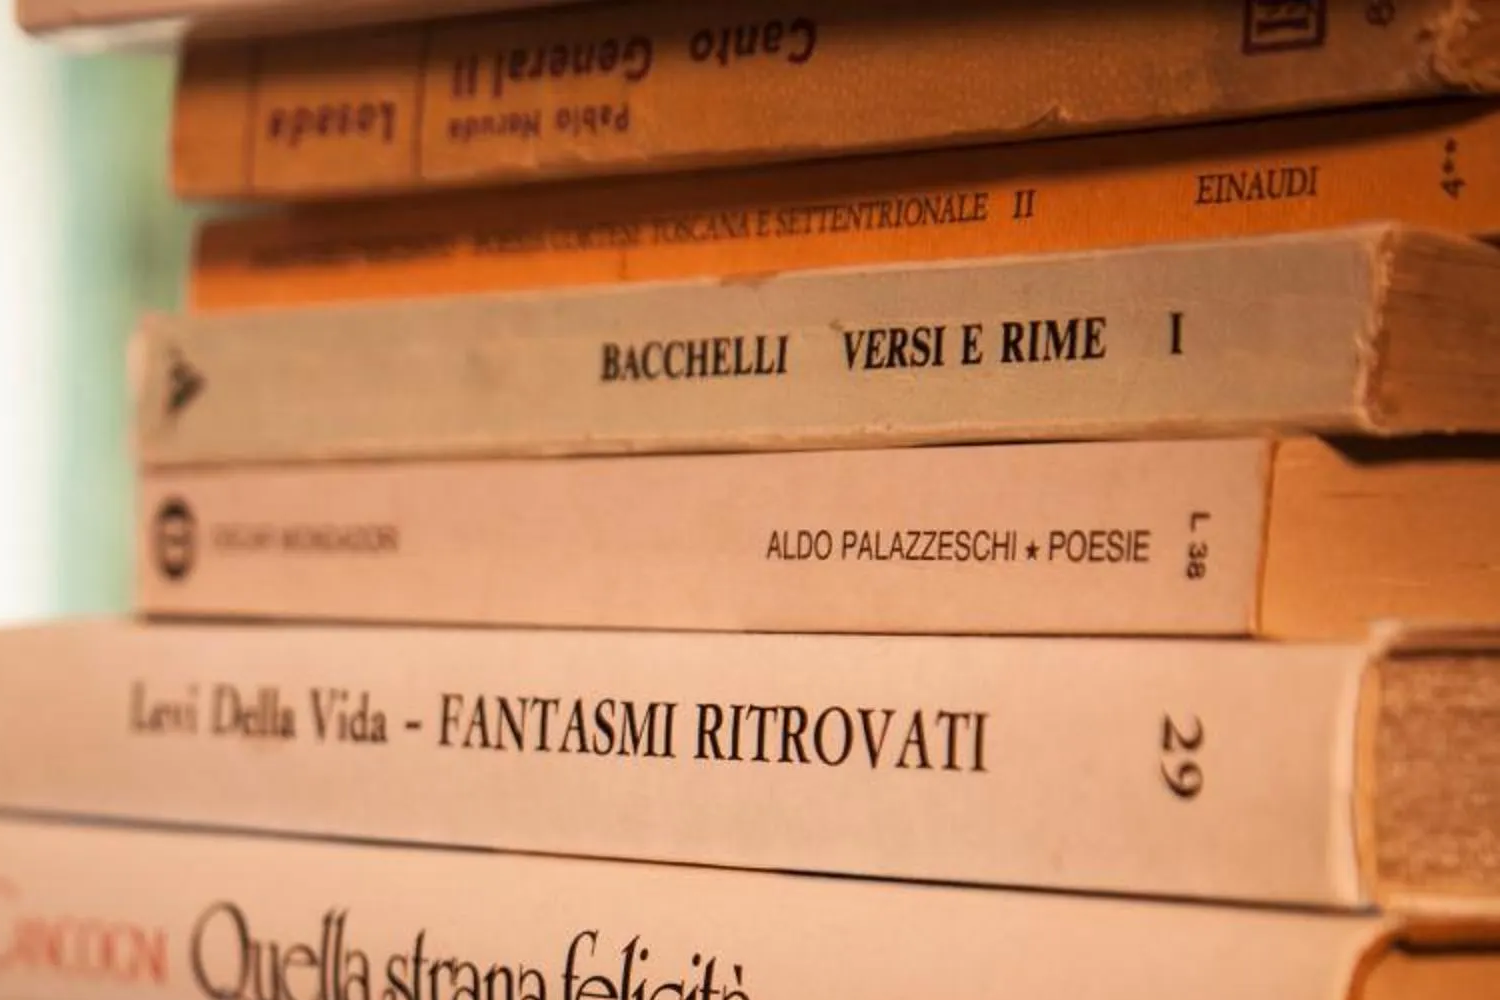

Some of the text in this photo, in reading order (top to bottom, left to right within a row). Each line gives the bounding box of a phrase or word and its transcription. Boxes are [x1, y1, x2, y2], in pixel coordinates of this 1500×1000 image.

[688, 18, 818, 66] Canto
[1196, 166, 1319, 204] EINAUDI
[775, 191, 990, 238] SETTENTRIONALE
[1012, 189, 1037, 219] II
[600, 312, 1184, 382] BACCHELLI VERSI E RIME I
[766, 529, 1151, 562] ALDO PALAZZESCHI POESIE
[211, 684, 296, 741] Della
[310, 688, 388, 743] Vida
[438, 693, 674, 758] FANTASMI
[693, 703, 990, 773] RITROVATI
[1160, 713, 1203, 800] 29
